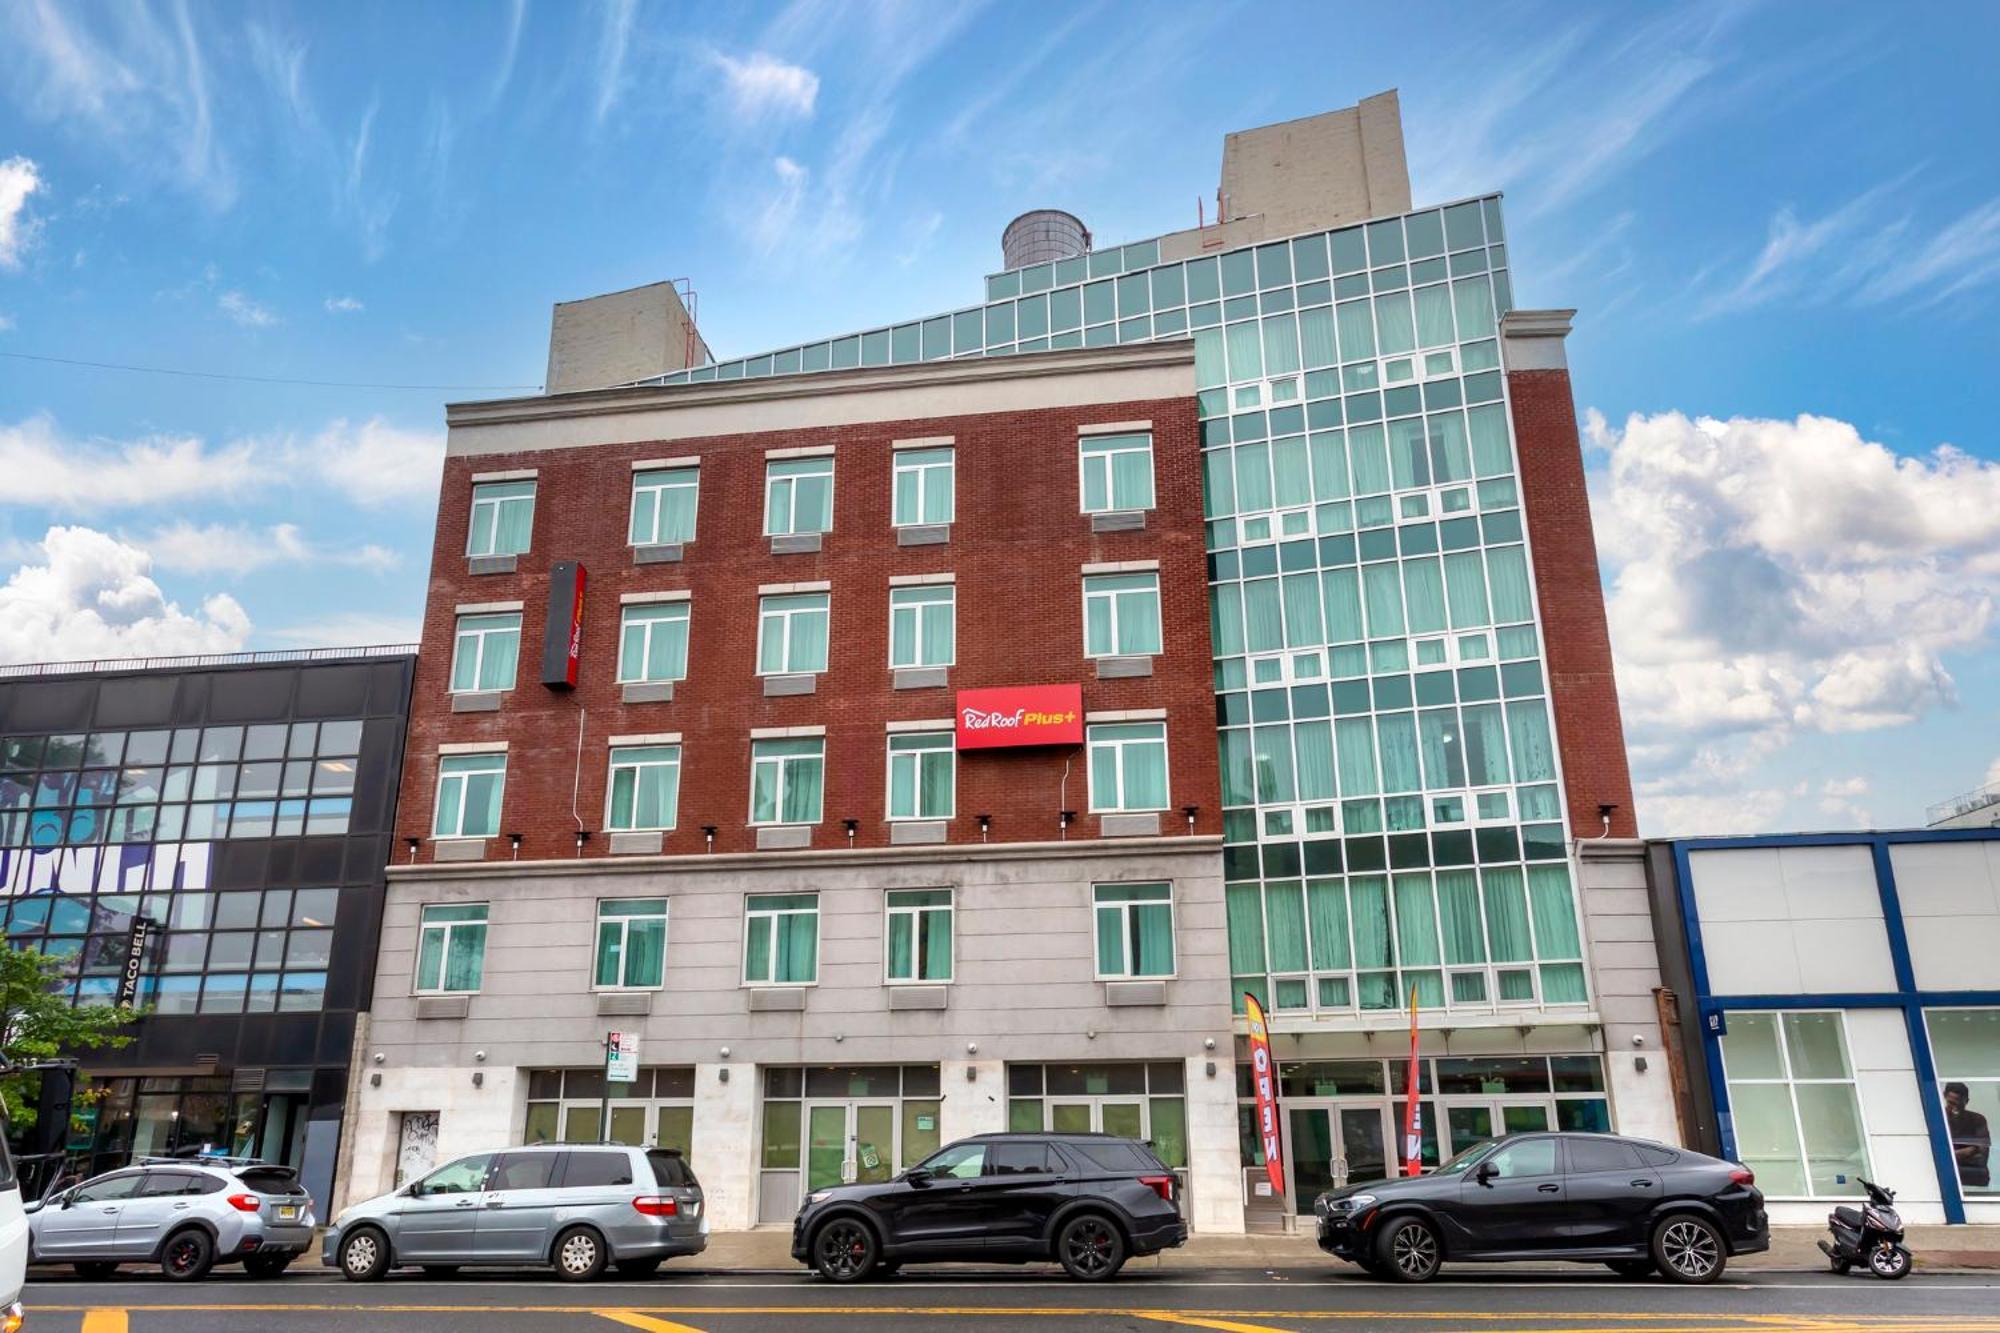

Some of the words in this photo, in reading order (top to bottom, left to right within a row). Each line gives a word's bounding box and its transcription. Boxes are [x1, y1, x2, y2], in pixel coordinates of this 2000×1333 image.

[1024, 711, 1076, 725] Plus+
[123, 959, 139, 997] TACO
[131, 922, 147, 956] BELL
